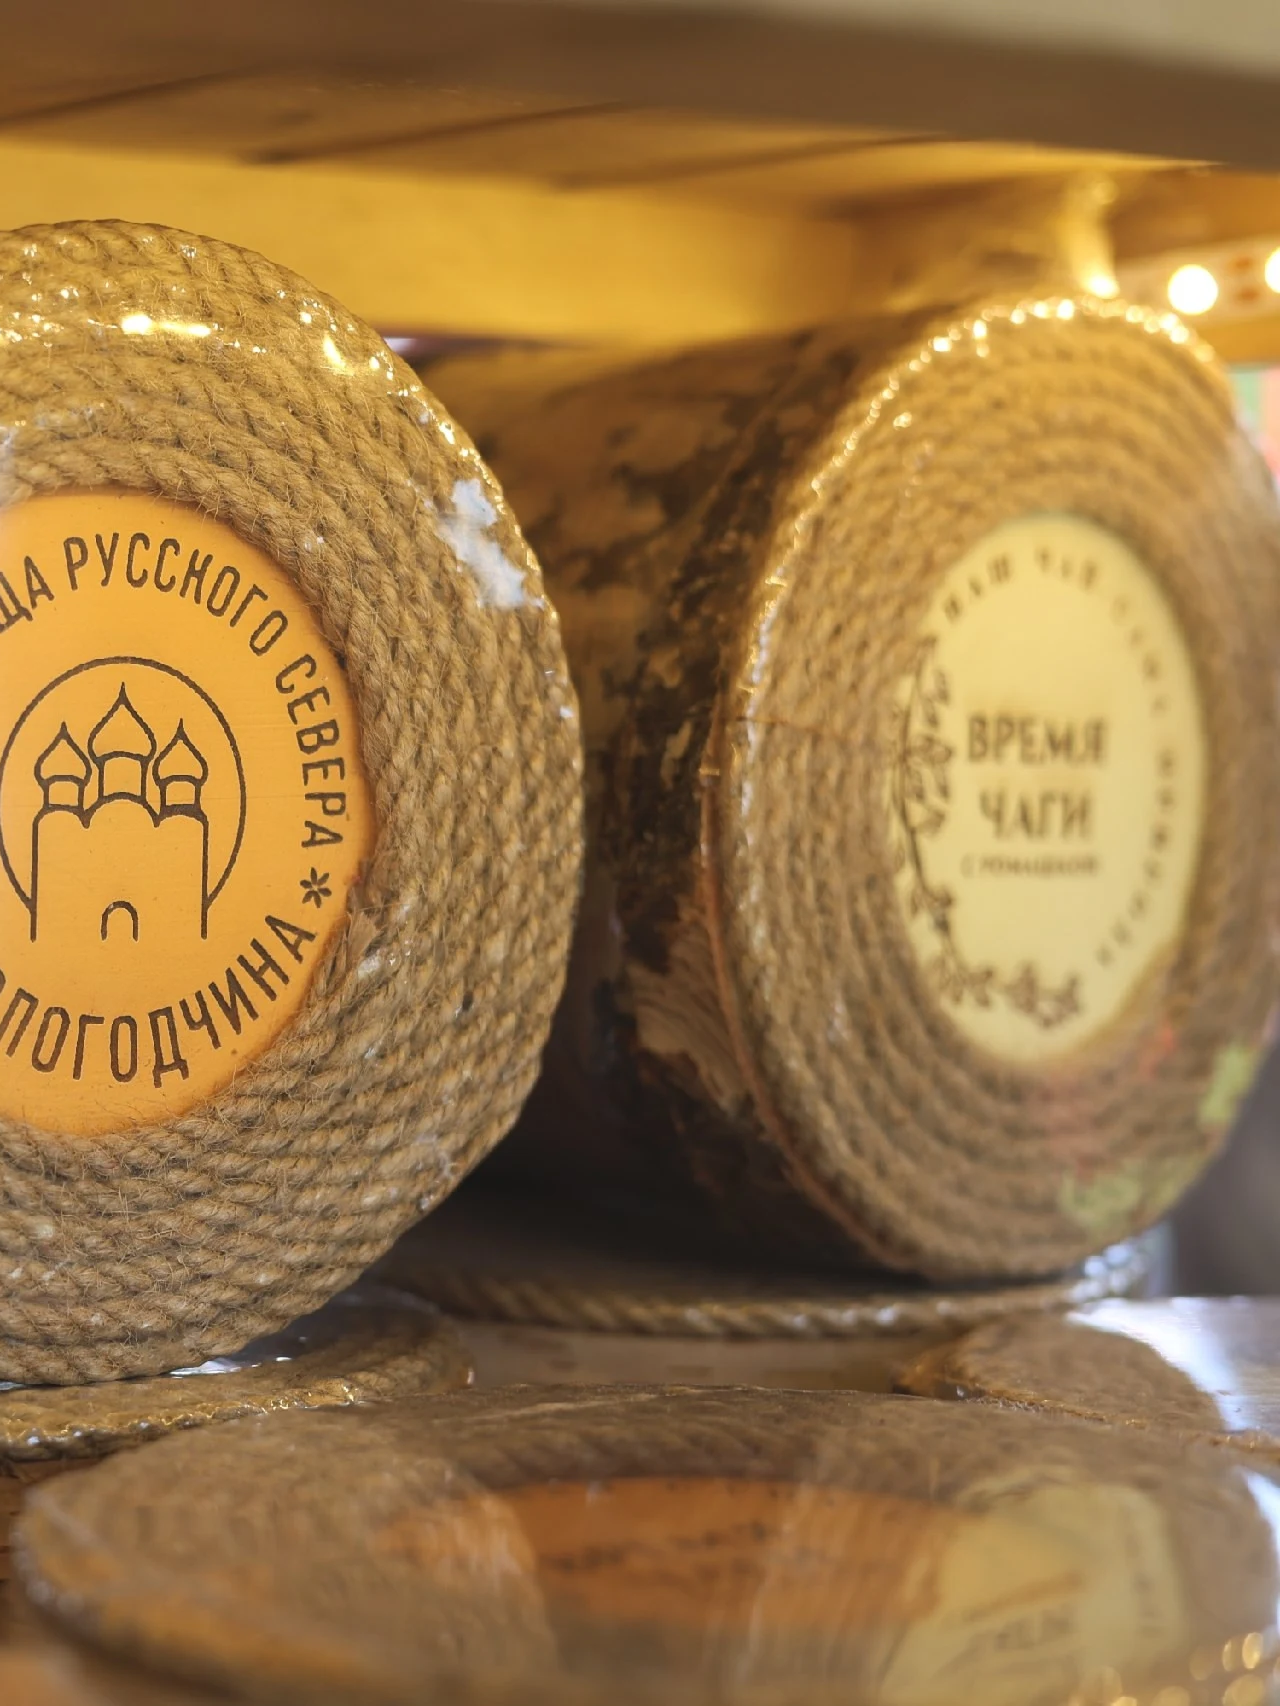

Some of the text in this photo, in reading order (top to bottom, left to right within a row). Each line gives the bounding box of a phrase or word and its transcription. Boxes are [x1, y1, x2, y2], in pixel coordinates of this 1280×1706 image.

[63, 532, 289, 656] РУССКОГО
[275, 653, 348, 849] СЕВЕРА
[967, 712, 1108, 768] ВРЕМЯ
[978, 787, 1094, 840] ЧАГИ
